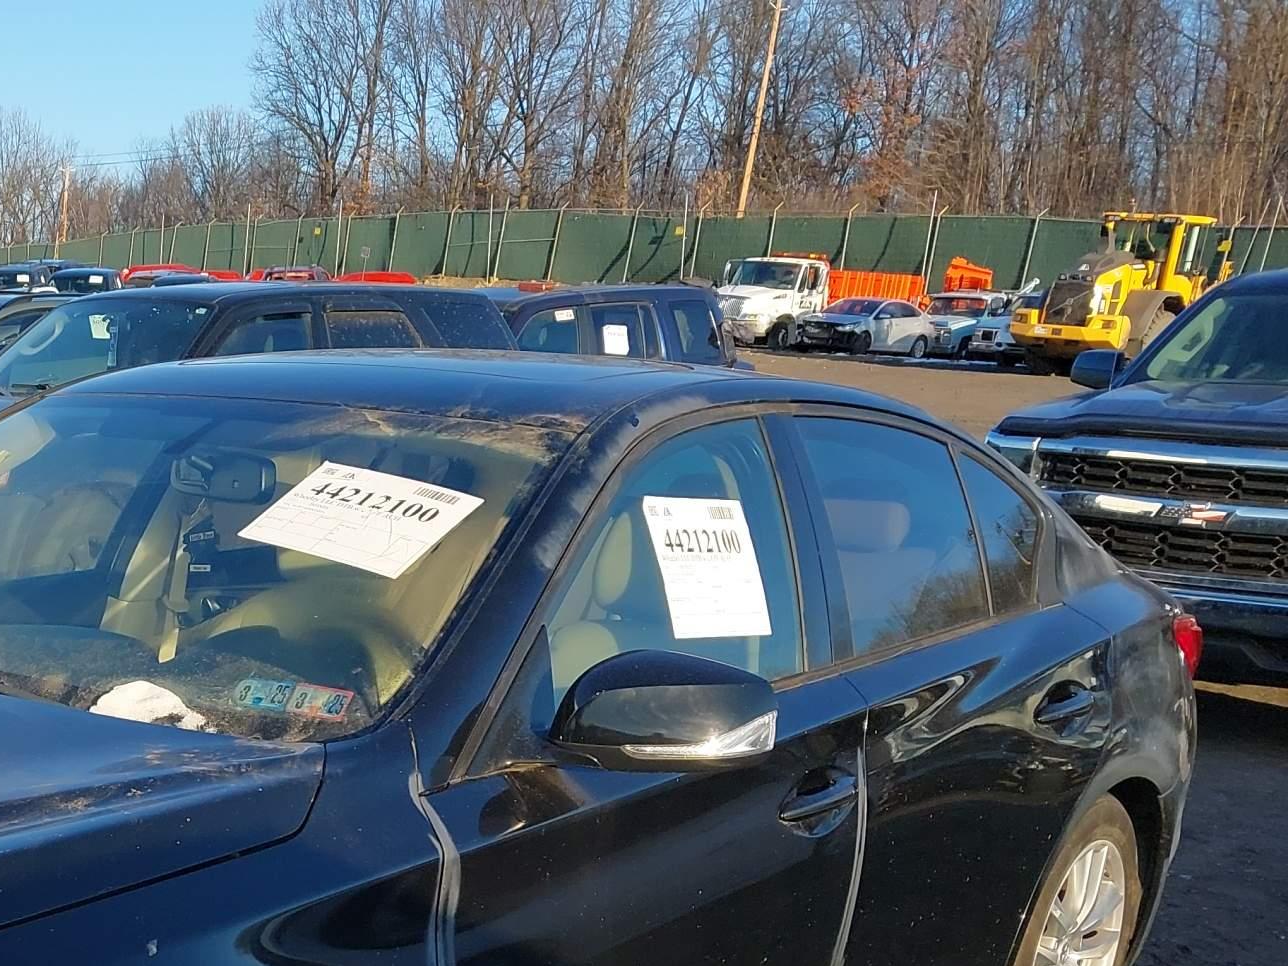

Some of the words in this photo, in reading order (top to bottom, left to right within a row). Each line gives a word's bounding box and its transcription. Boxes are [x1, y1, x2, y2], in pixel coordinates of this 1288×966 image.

[310, 482, 440, 523] 44212100
[664, 528, 741, 554] 44212100
[239, 685, 252, 702] 3
[270, 684, 290, 705] 25
[295, 691, 309, 710] 3
[327, 693, 349, 716] 25
